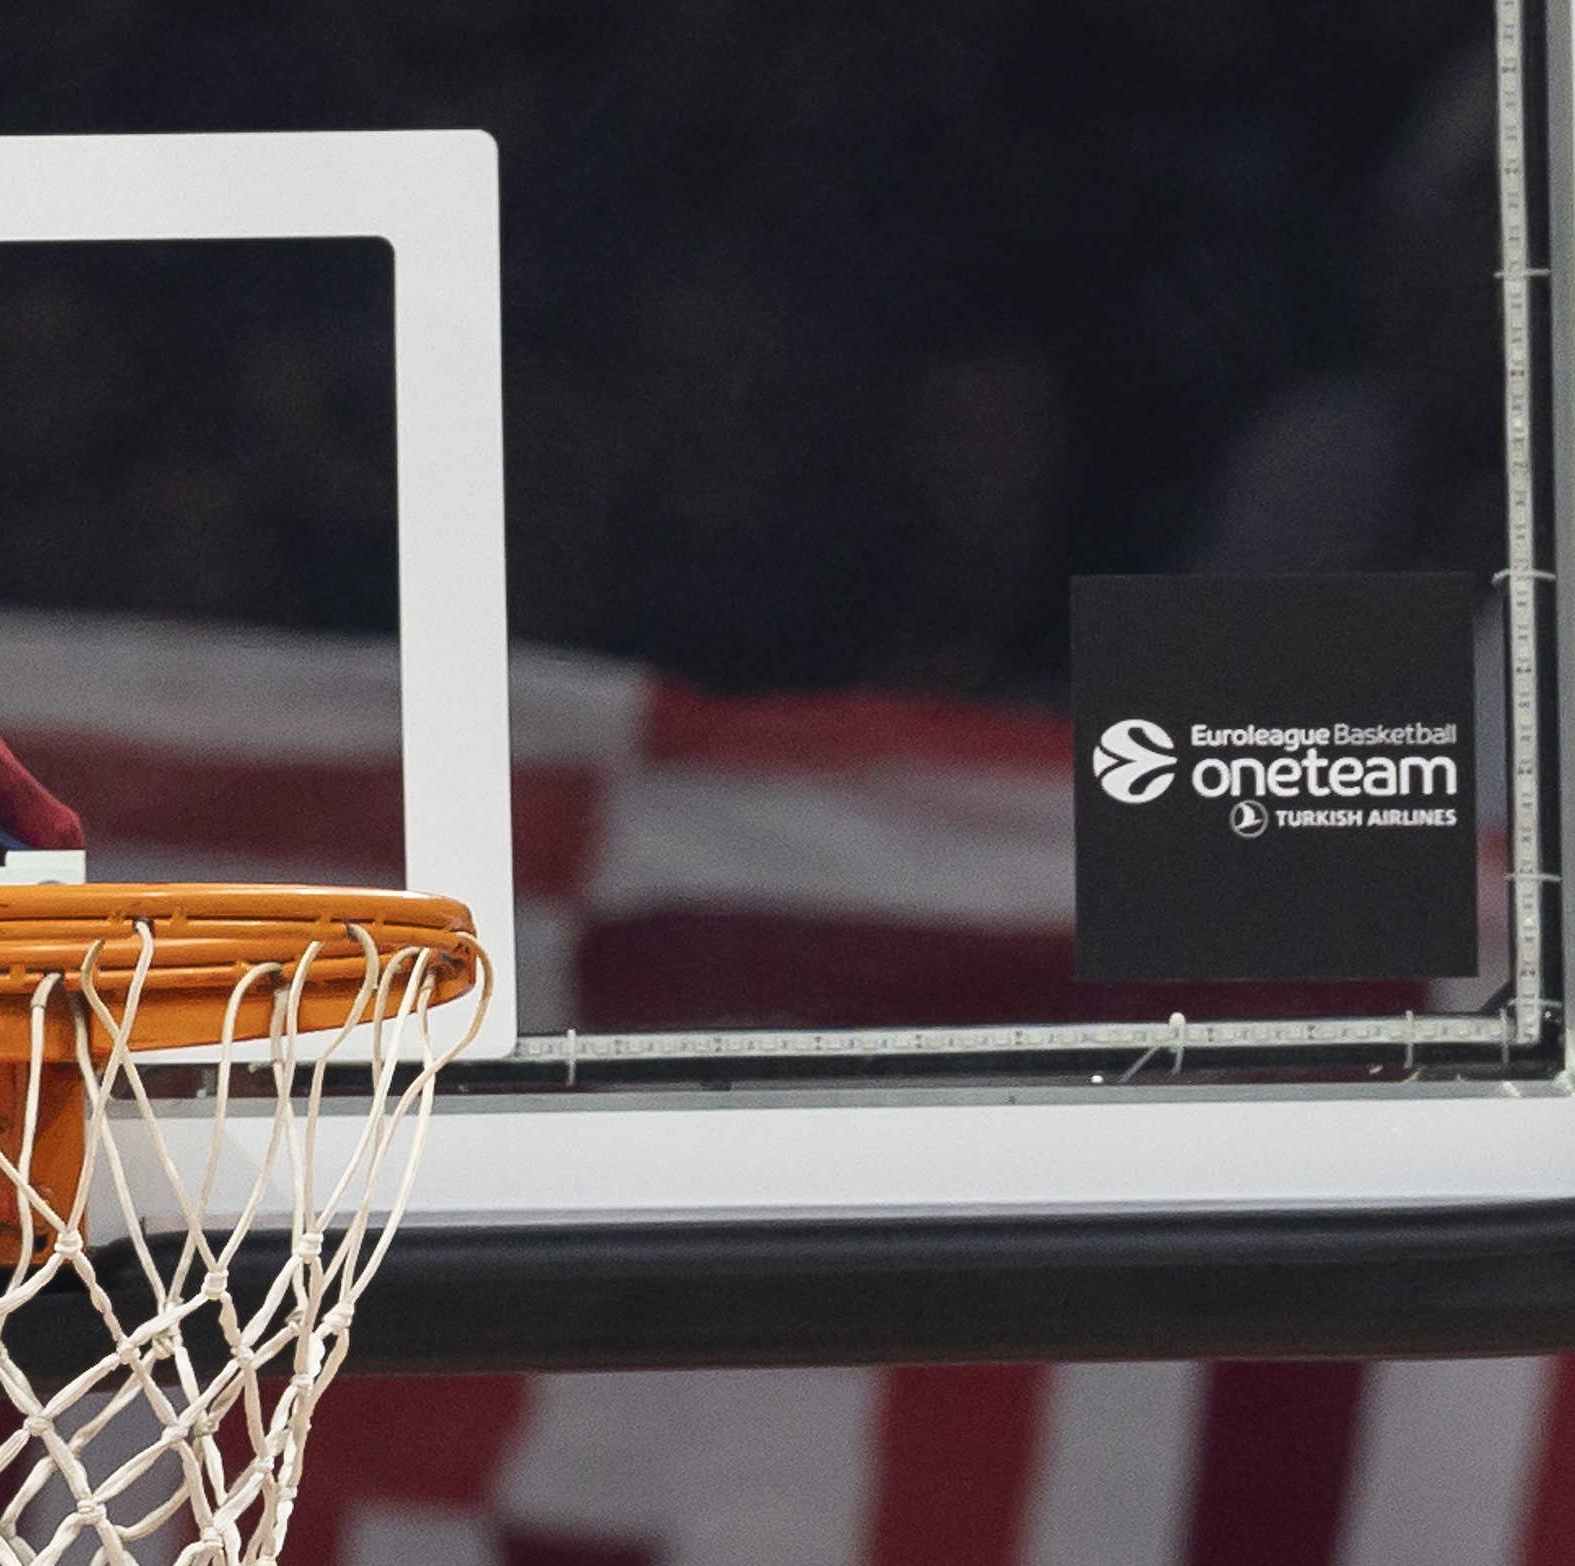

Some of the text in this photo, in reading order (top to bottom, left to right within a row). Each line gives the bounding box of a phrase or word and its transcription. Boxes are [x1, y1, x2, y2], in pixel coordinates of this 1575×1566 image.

[1191, 722, 1457, 751] Euroleague Basketball
[1191, 748, 1458, 798] oneteam
[1276, 808, 1458, 828] TURKISH AIRLINES
